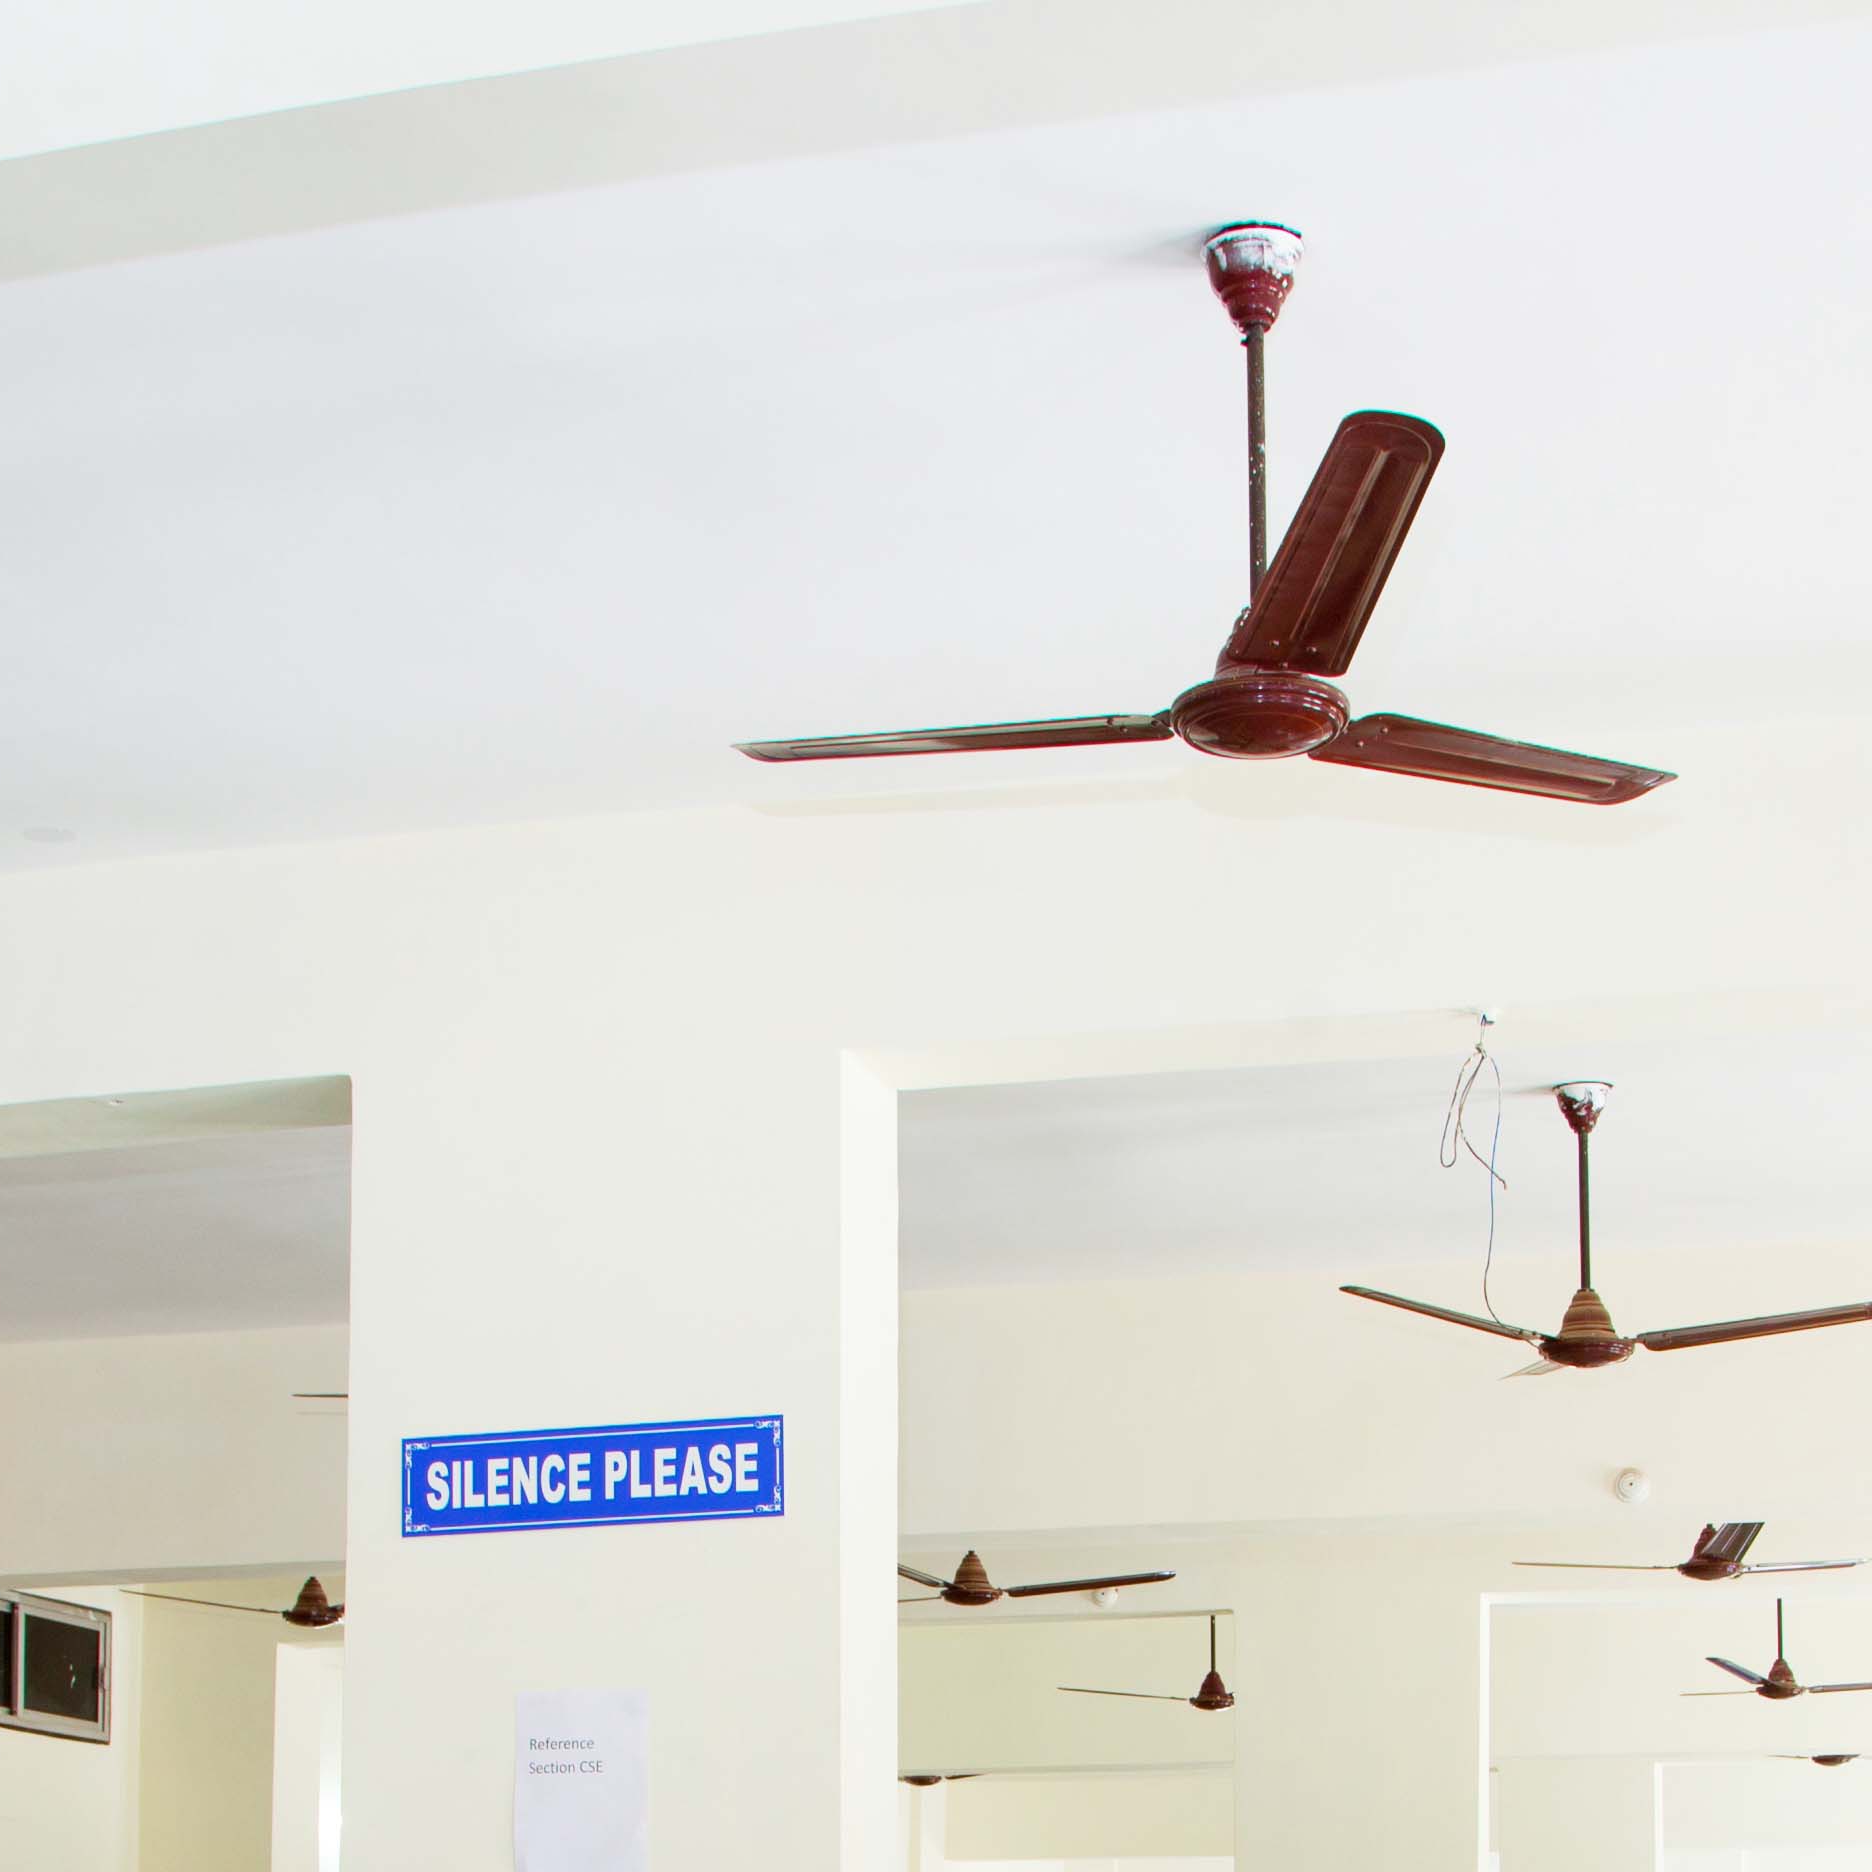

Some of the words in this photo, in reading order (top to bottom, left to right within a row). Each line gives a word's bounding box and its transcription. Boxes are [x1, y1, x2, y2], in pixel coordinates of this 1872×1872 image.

[426, 1453, 592, 1511] SILENCE
[604, 1442, 760, 1500] PLEASE
[529, 1737, 595, 1751] Reference
[529, 1760, 576, 1774] Section
[579, 1760, 605, 1774] CSE
